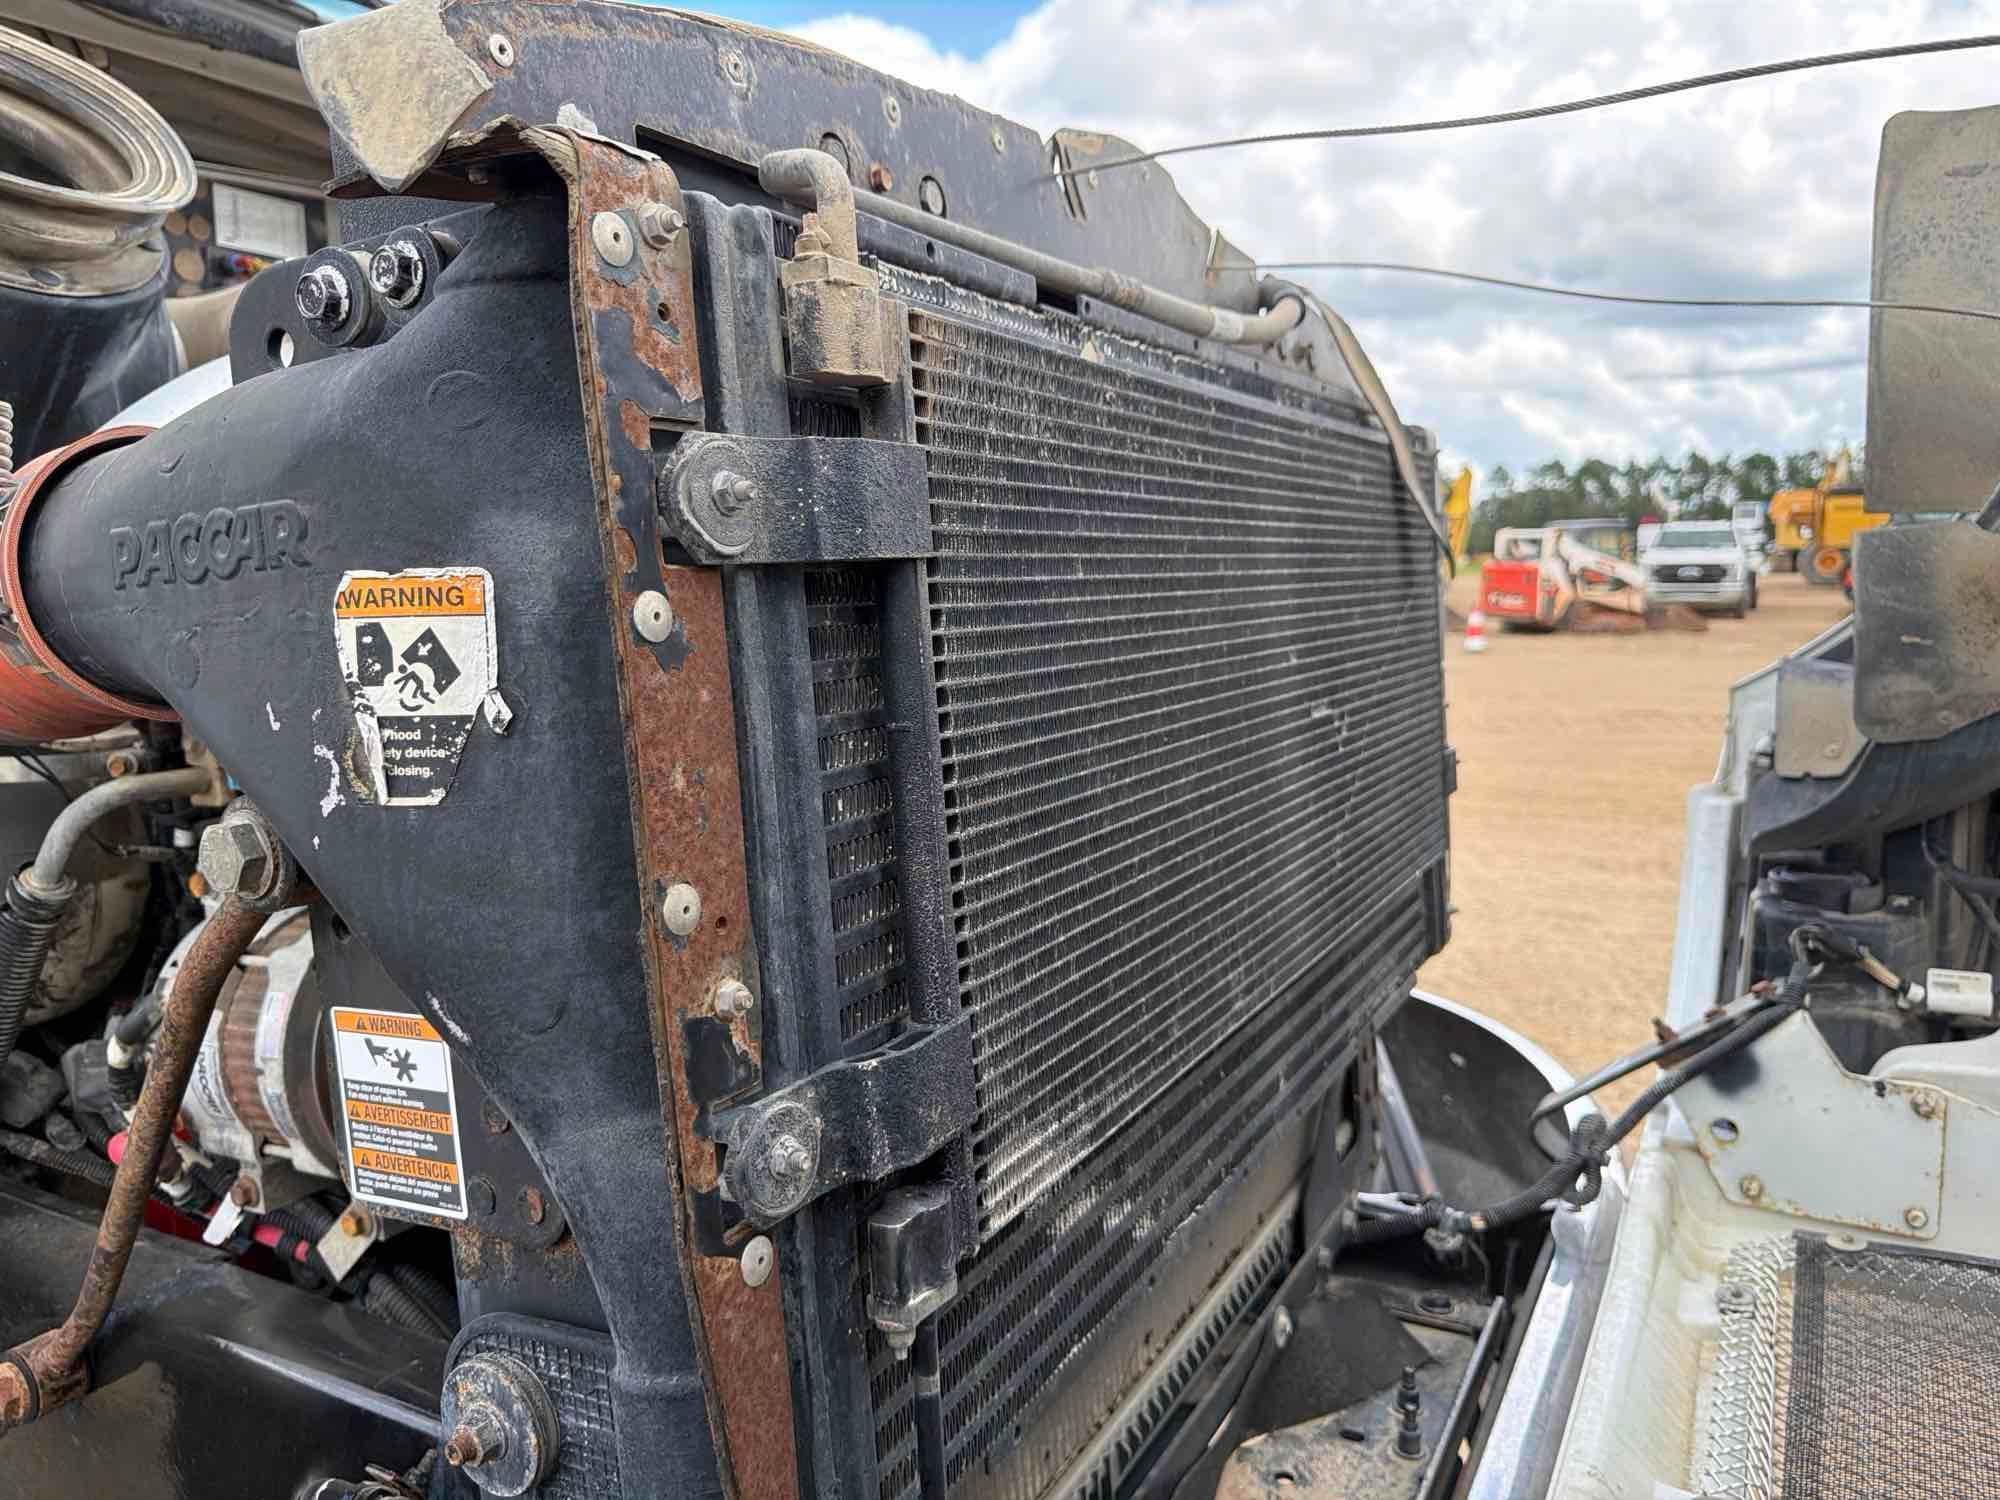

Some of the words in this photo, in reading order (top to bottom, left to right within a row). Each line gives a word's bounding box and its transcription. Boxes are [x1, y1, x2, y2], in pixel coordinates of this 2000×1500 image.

[110, 499, 312, 590] PACCAR
[341, 586, 464, 609] WARNING
[405, 747, 446, 759] device
[368, 1016, 422, 1037] WARNING
[364, 1103, 450, 1131] AVERTISSEMENT
[375, 1154, 452, 1181] ADVERTENCIA
